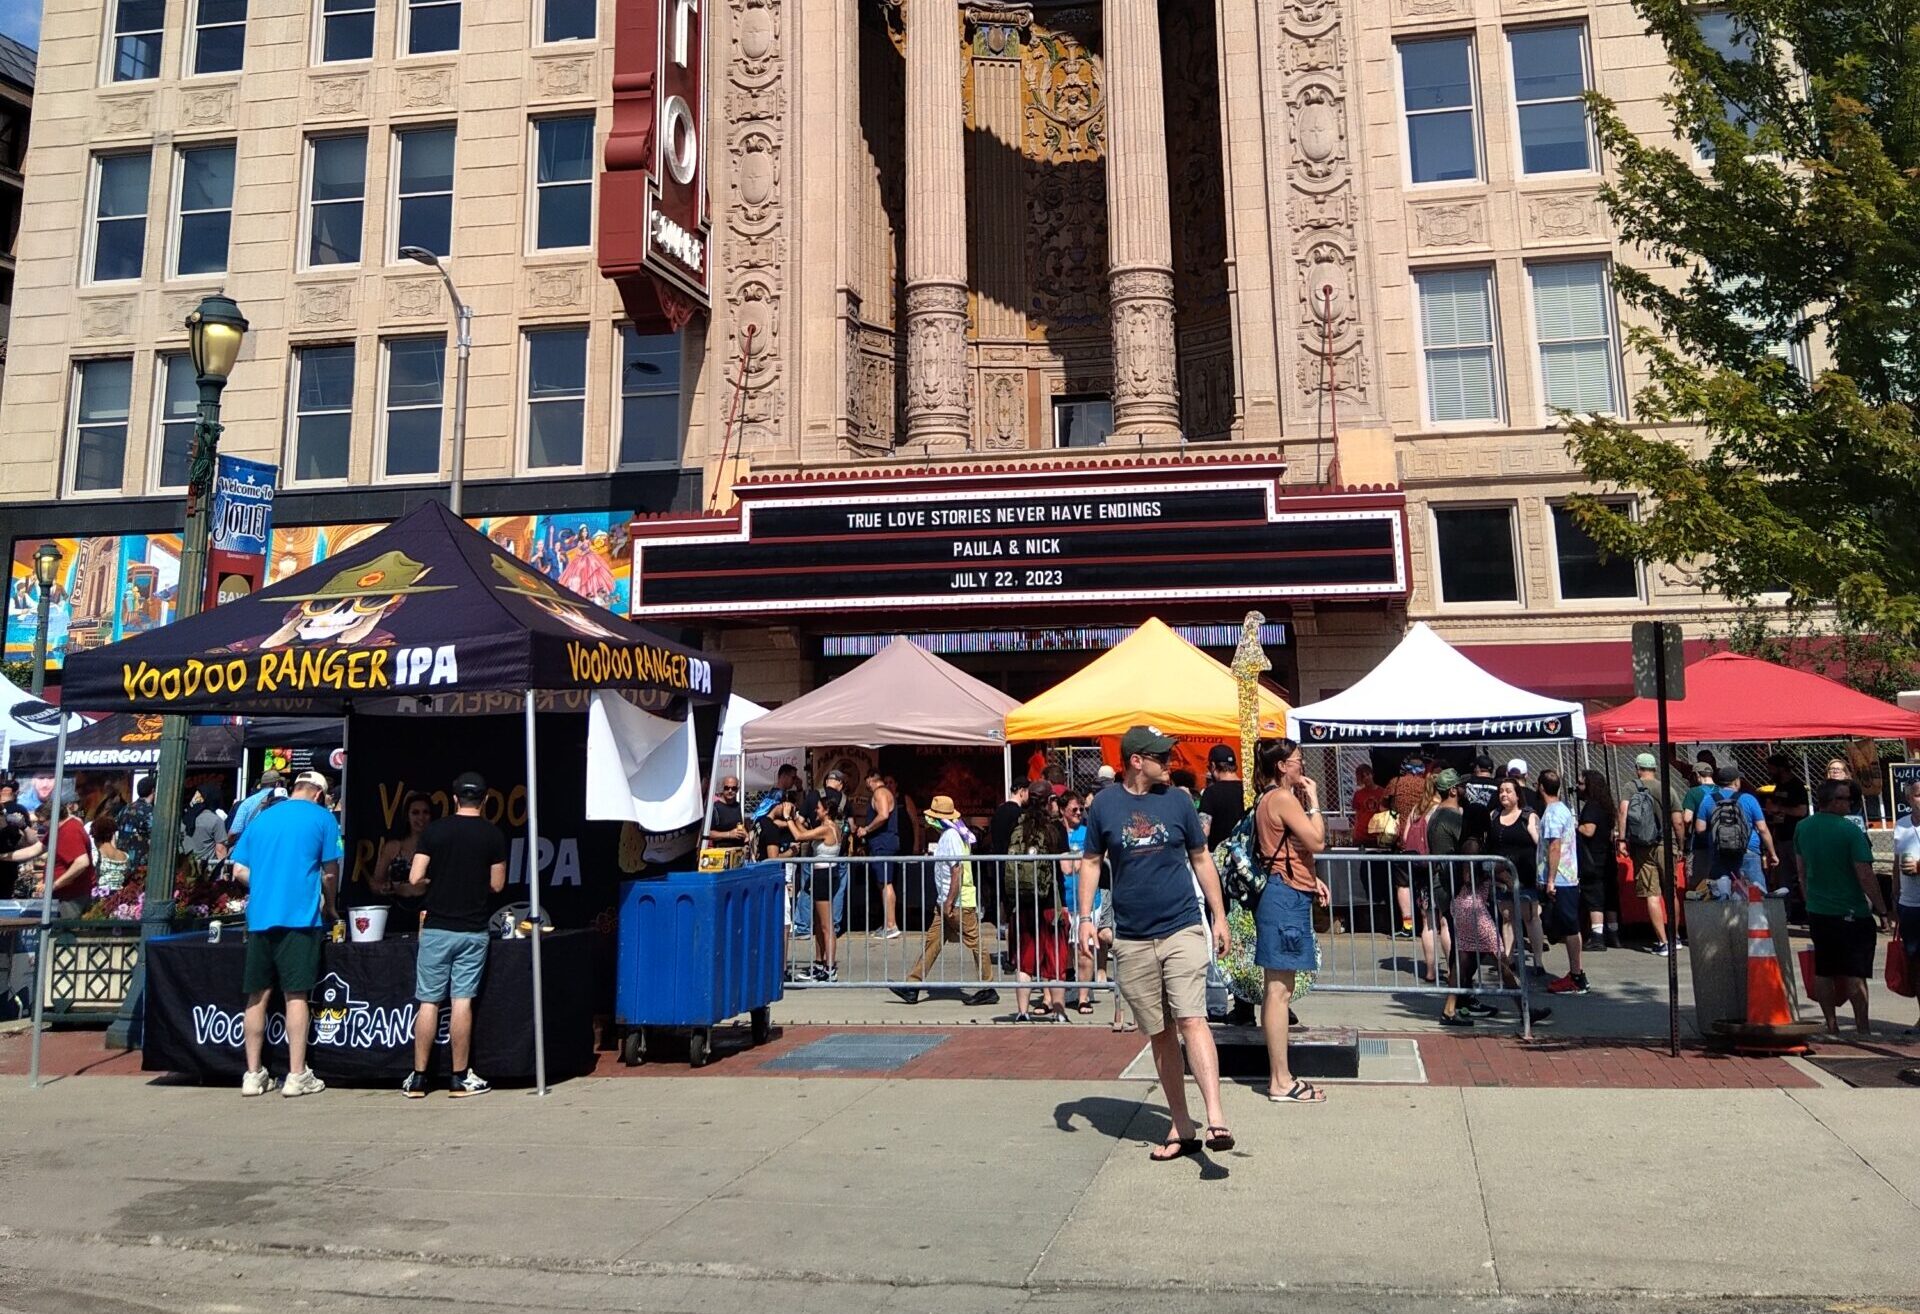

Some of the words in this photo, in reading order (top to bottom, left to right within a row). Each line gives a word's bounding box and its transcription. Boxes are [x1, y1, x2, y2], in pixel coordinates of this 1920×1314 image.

[218, 477, 260, 498] Welcome
[262, 484, 274, 500] To
[212, 497, 272, 543] JOLIET
[847, 513, 882, 529] TRUE
[888, 512, 925, 527] LOVE
[931, 509, 991, 525] STORIES
[997, 506, 1045, 523] NEVER
[1051, 504, 1093, 521] HAVE
[1099, 501, 1161, 518] ENDINGS
[953, 540, 1003, 557] PAULA
[1009, 540, 1020, 555] &
[1026, 538, 1061, 555] NICK
[951, 571, 987, 588] JULY
[995, 571, 1019, 587] 22,
[1026, 570, 1063, 585] 2023
[123, 659, 247, 701] VOODOO
[257, 648, 389, 691] RANGER
[395, 644, 458, 686] IPA
[567, 640, 633, 684] VOODOO
[634, 645, 689, 689] RANGER
[688, 657, 712, 694] IPA
[64, 748, 161, 765] GINGERGOAT
